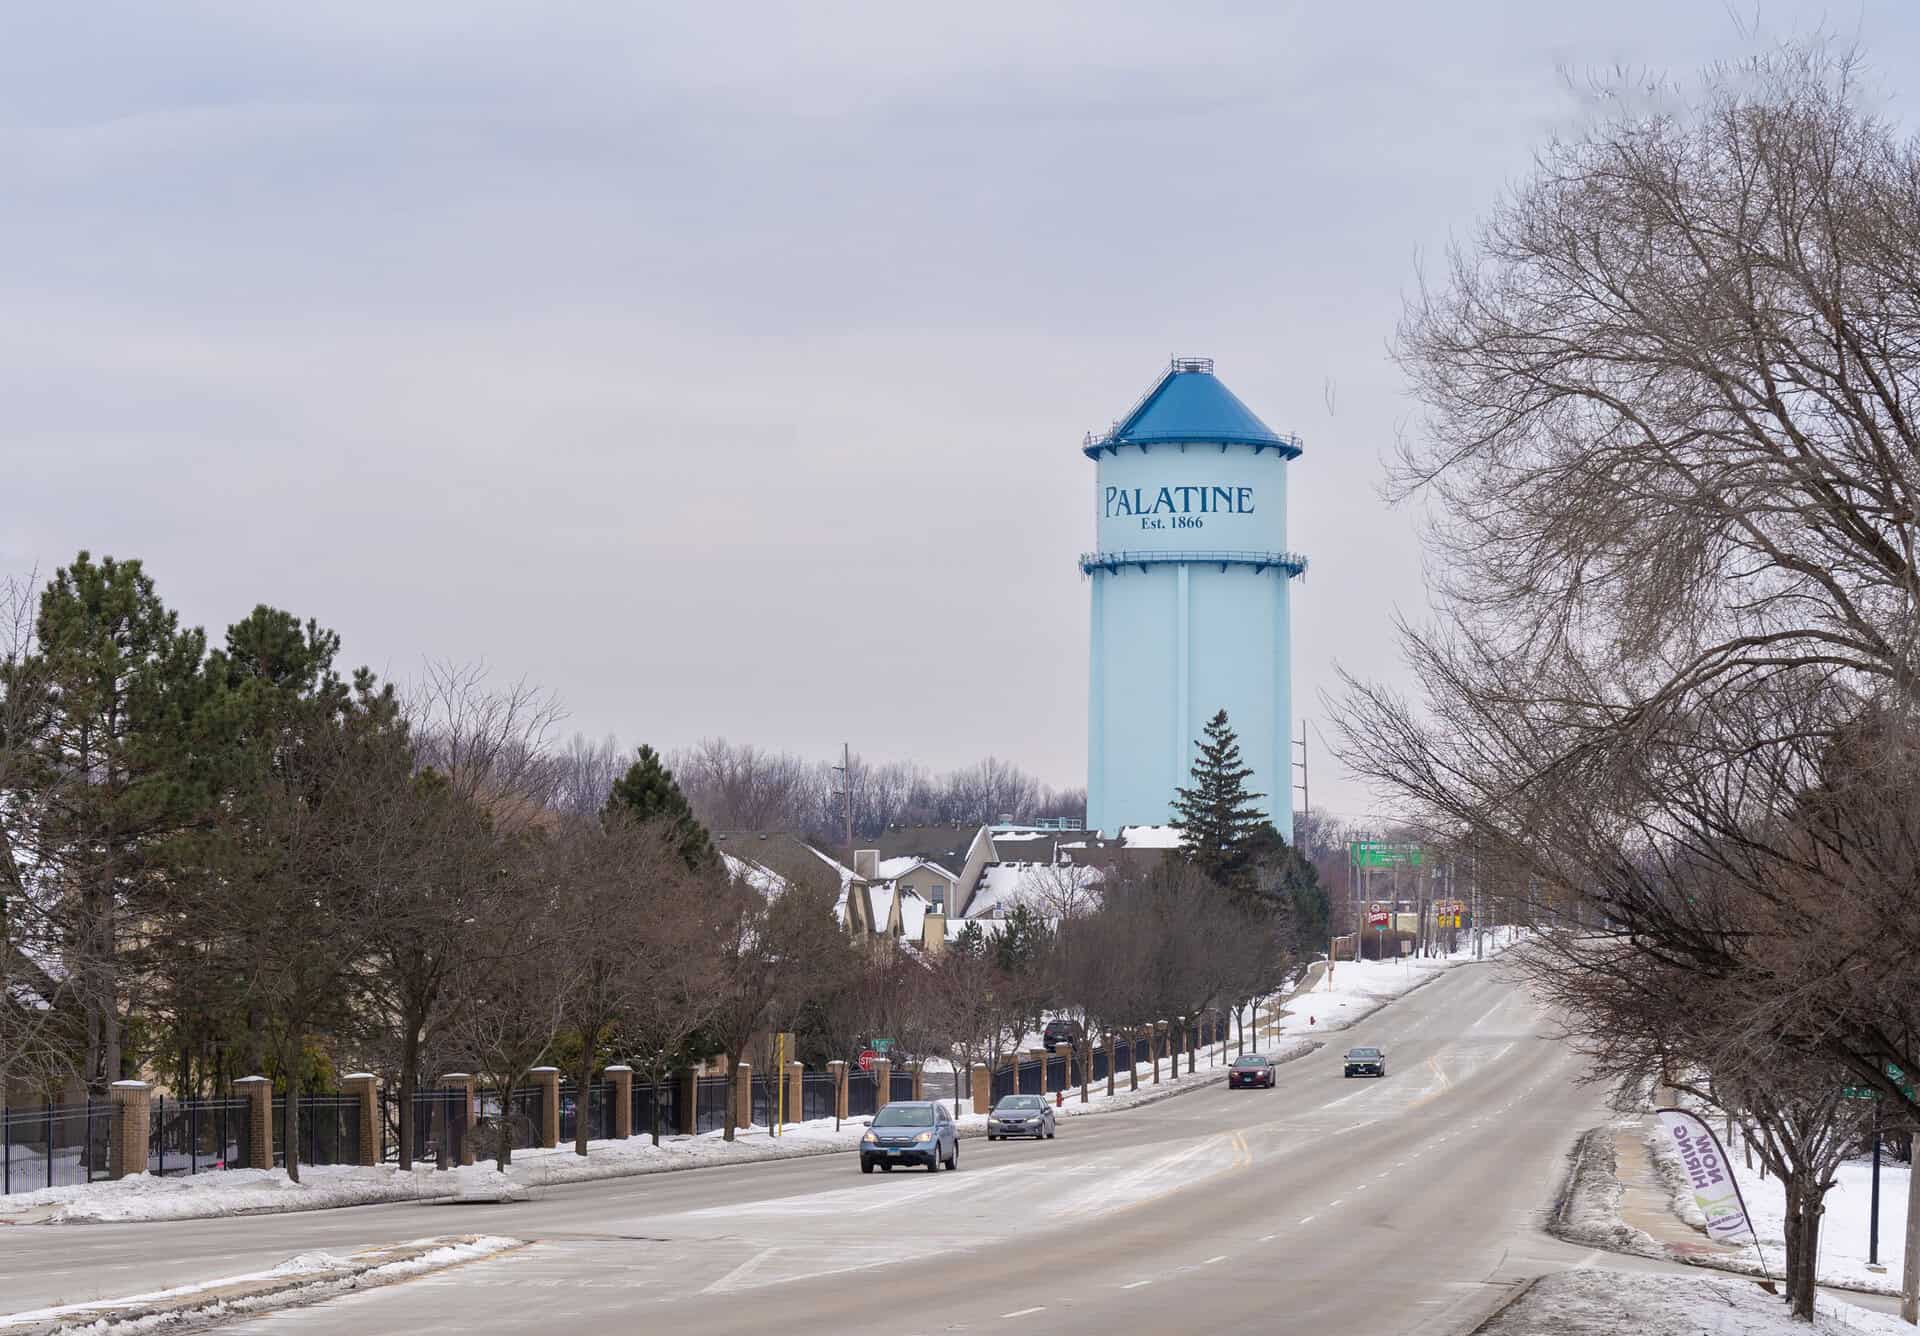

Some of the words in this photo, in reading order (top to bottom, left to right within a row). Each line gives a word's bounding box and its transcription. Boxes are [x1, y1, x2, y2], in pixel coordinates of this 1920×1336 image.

[1105, 486, 1254, 517] PALATINE
[1141, 517, 1166, 529] Est.
[1171, 516, 1203, 529] 1866
